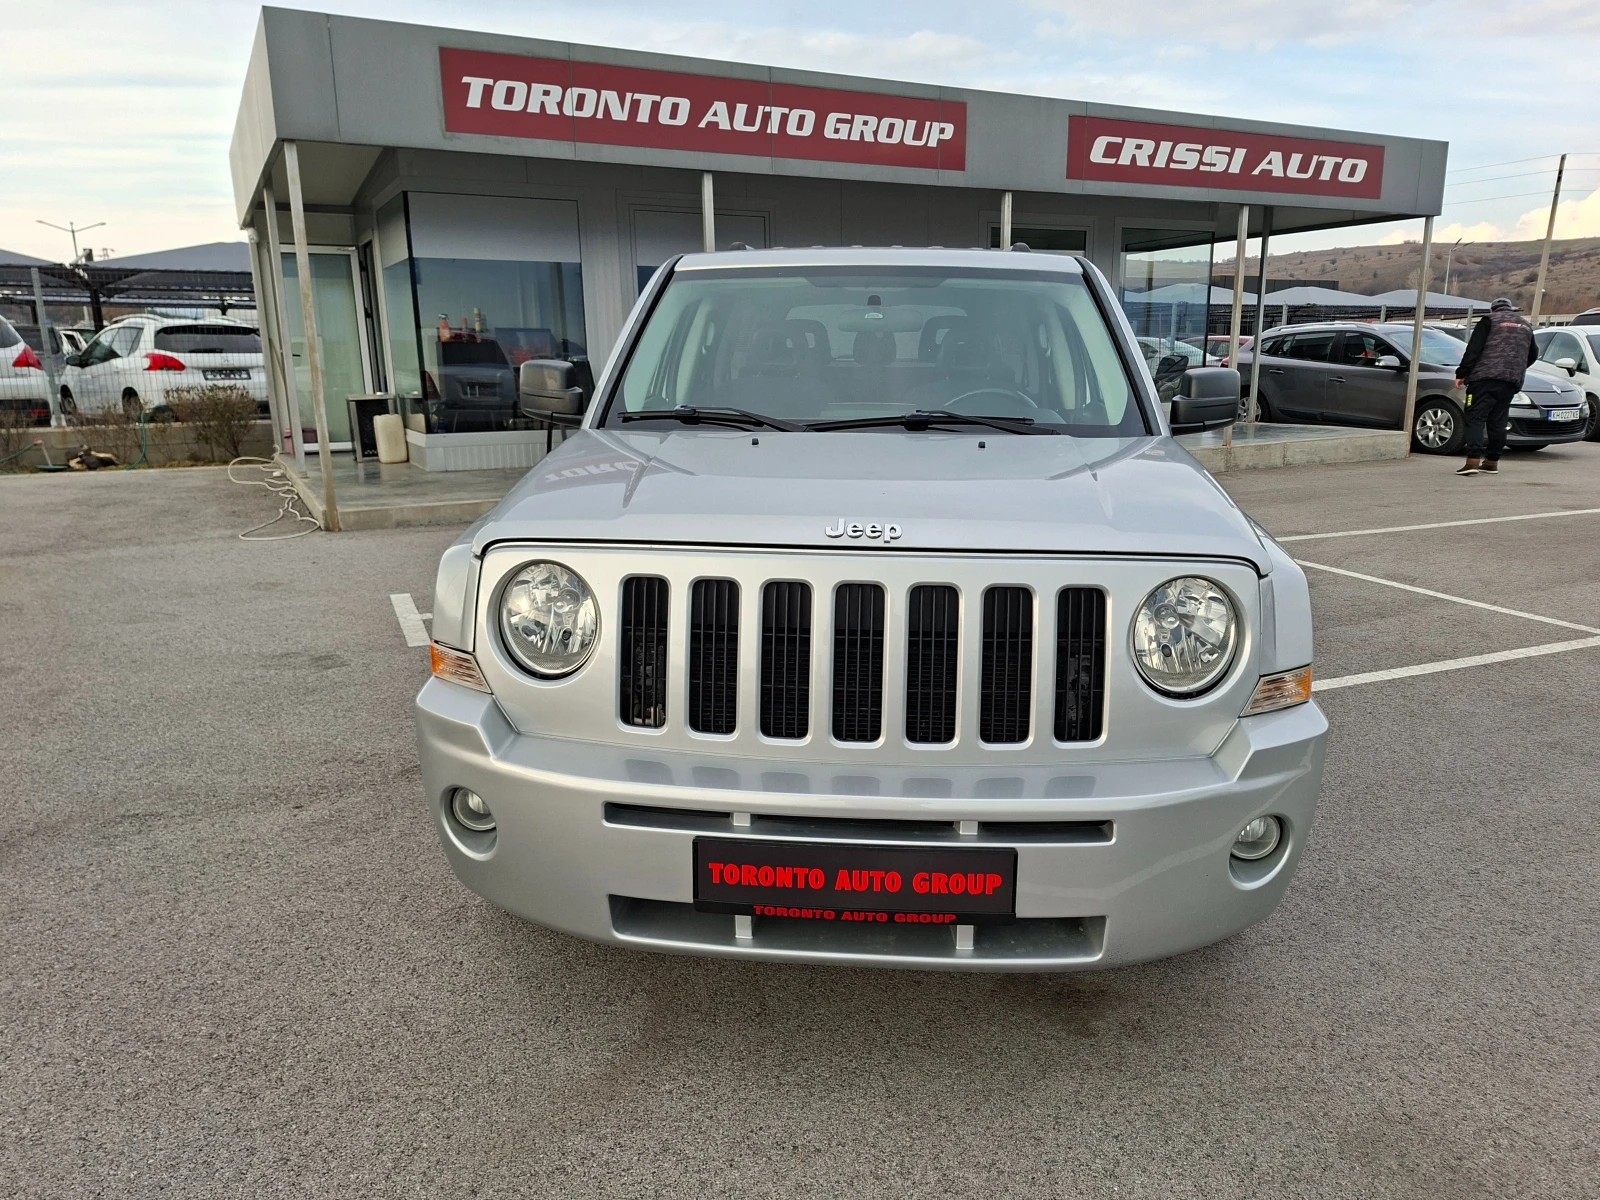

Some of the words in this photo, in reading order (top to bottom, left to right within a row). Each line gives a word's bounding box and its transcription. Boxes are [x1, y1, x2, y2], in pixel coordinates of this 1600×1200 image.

[461, 76, 691, 126] TORONTO
[698, 100, 816, 137] AUTO
[823, 112, 955, 148] GROUP
[1089, 135, 1247, 174] CRISSI
[1251, 150, 1368, 183] AUTO
[825, 518, 903, 543] Jeep
[708, 862, 825, 890] TORONTO
[834, 869, 902, 893] AUTO
[912, 871, 1003, 895] GROUP
[753, 905, 836, 920] TORONTO
[841, 911, 888, 922] AUTO
[894, 913, 957, 924] GROUP
